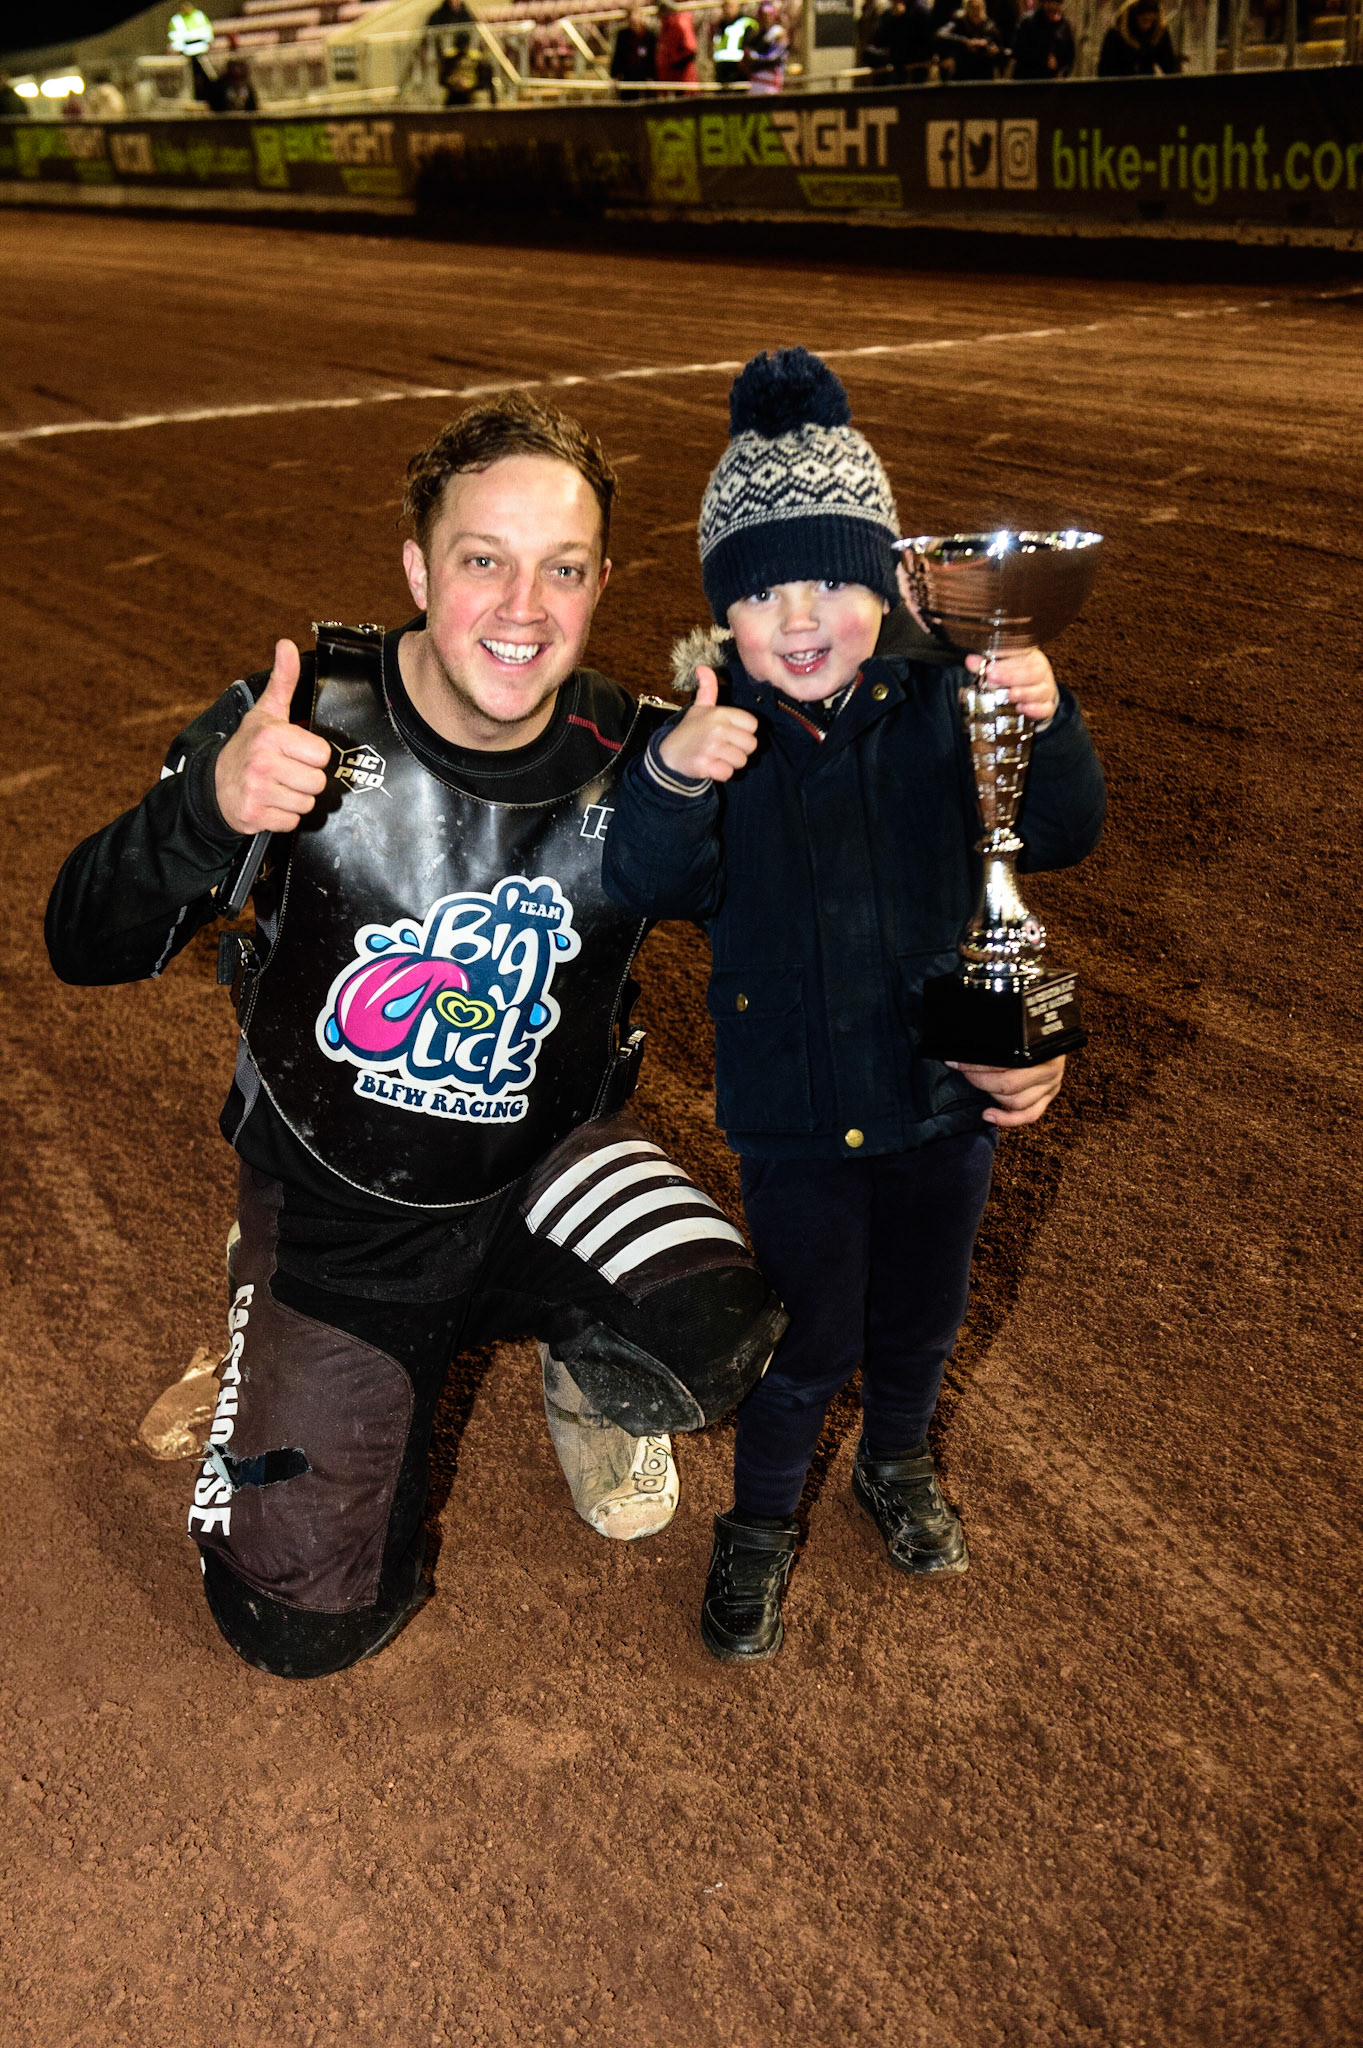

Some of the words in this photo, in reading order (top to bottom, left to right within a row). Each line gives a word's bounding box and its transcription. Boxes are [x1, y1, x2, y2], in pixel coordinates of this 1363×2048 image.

[701, 106, 899, 168] BIKERIGHT
[333, 765, 385, 789] PRO
[346, 753, 381, 771] JC
[518, 899, 563, 921] TEAM
[430, 902, 540, 1011] Big
[359, 1074, 427, 1107] BLFW
[430, 1093, 524, 1119] RACING
